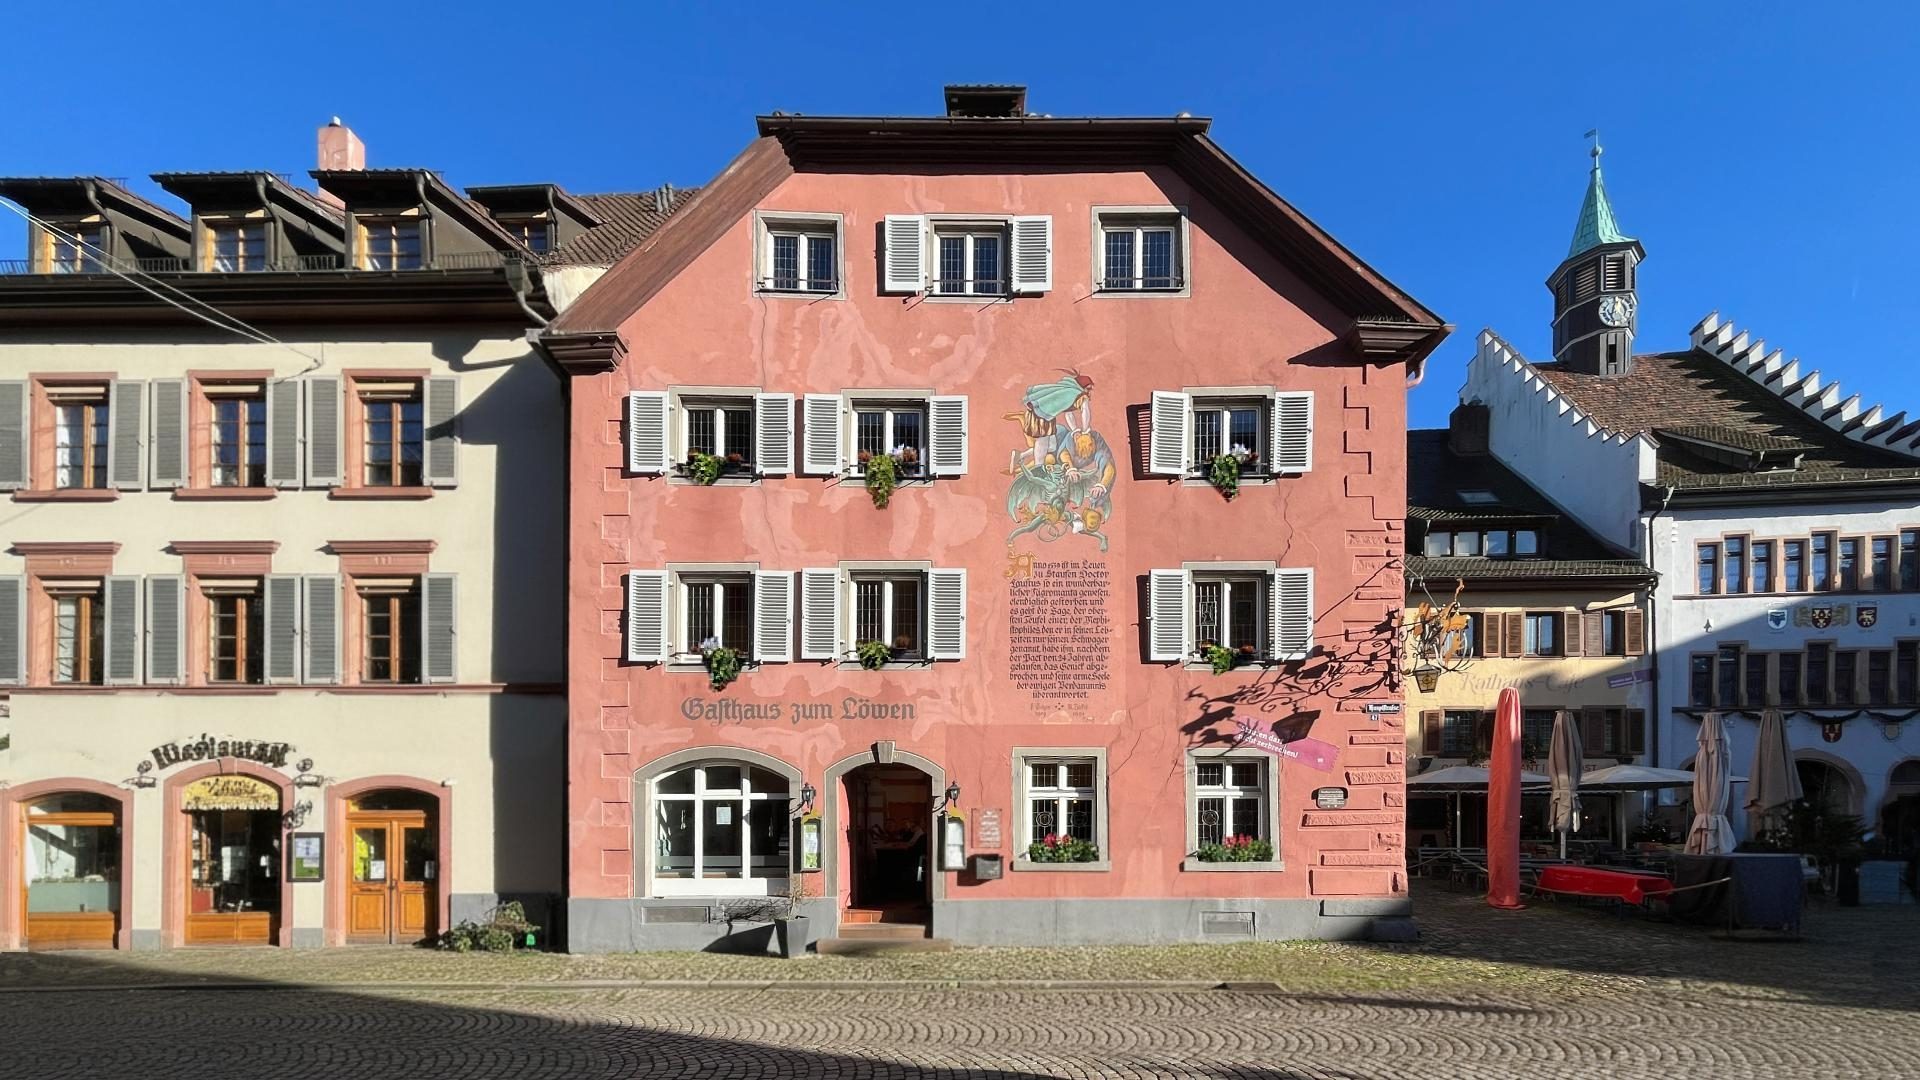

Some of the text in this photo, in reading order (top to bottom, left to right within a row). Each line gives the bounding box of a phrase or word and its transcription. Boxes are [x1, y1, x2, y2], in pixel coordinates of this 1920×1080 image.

[1061, 560, 1069, 570] ist
[1070, 561, 1080, 570] im
[1033, 569, 1110, 579] zu Staufen Doctor
[1052, 579, 1063, 587] ein
[1010, 588, 1030, 597] licher
[1050, 597, 1088, 607] gestorben
[1089, 598, 1104, 606] und
[1010, 607, 1018, 615] es
[1037, 607, 1048, 615] die
[1073, 606, 1086, 615] der
[1024, 615, 1046, 625] Teufel
[1069, 615, 1081, 624] der
[1041, 625, 1054, 634] den
[1055, 626, 1063, 634] er
[1064, 625, 1073, 634] in
[1073, 625, 1094, 635] seinen
[1032, 636, 1046, 644] nur
[1047, 635, 1069, 645] seinen
[1071, 634, 1109, 645] Schwager
[1042, 644, 1059, 654] habe
[1076, 644, 1111, 654] nachdem
[1009, 653, 1023, 662] der
[1043, 654, 1057, 662] von
[1067, 653, 1094, 662] Jahren
[1044, 662, 1058, 671] das
[1040, 671, 1054, 681] und
[1055, 671, 1072, 681] seine
[1072, 672, 1091, 681] arme
[1091, 671, 1111, 681] Seele
[1016, 681, 1028, 690] der
[1029, 681, 1056, 691] ewigen
[681, 697, 916, 727] Gasthaus zum Löwen
[1268, 734, 1284, 745] dar
